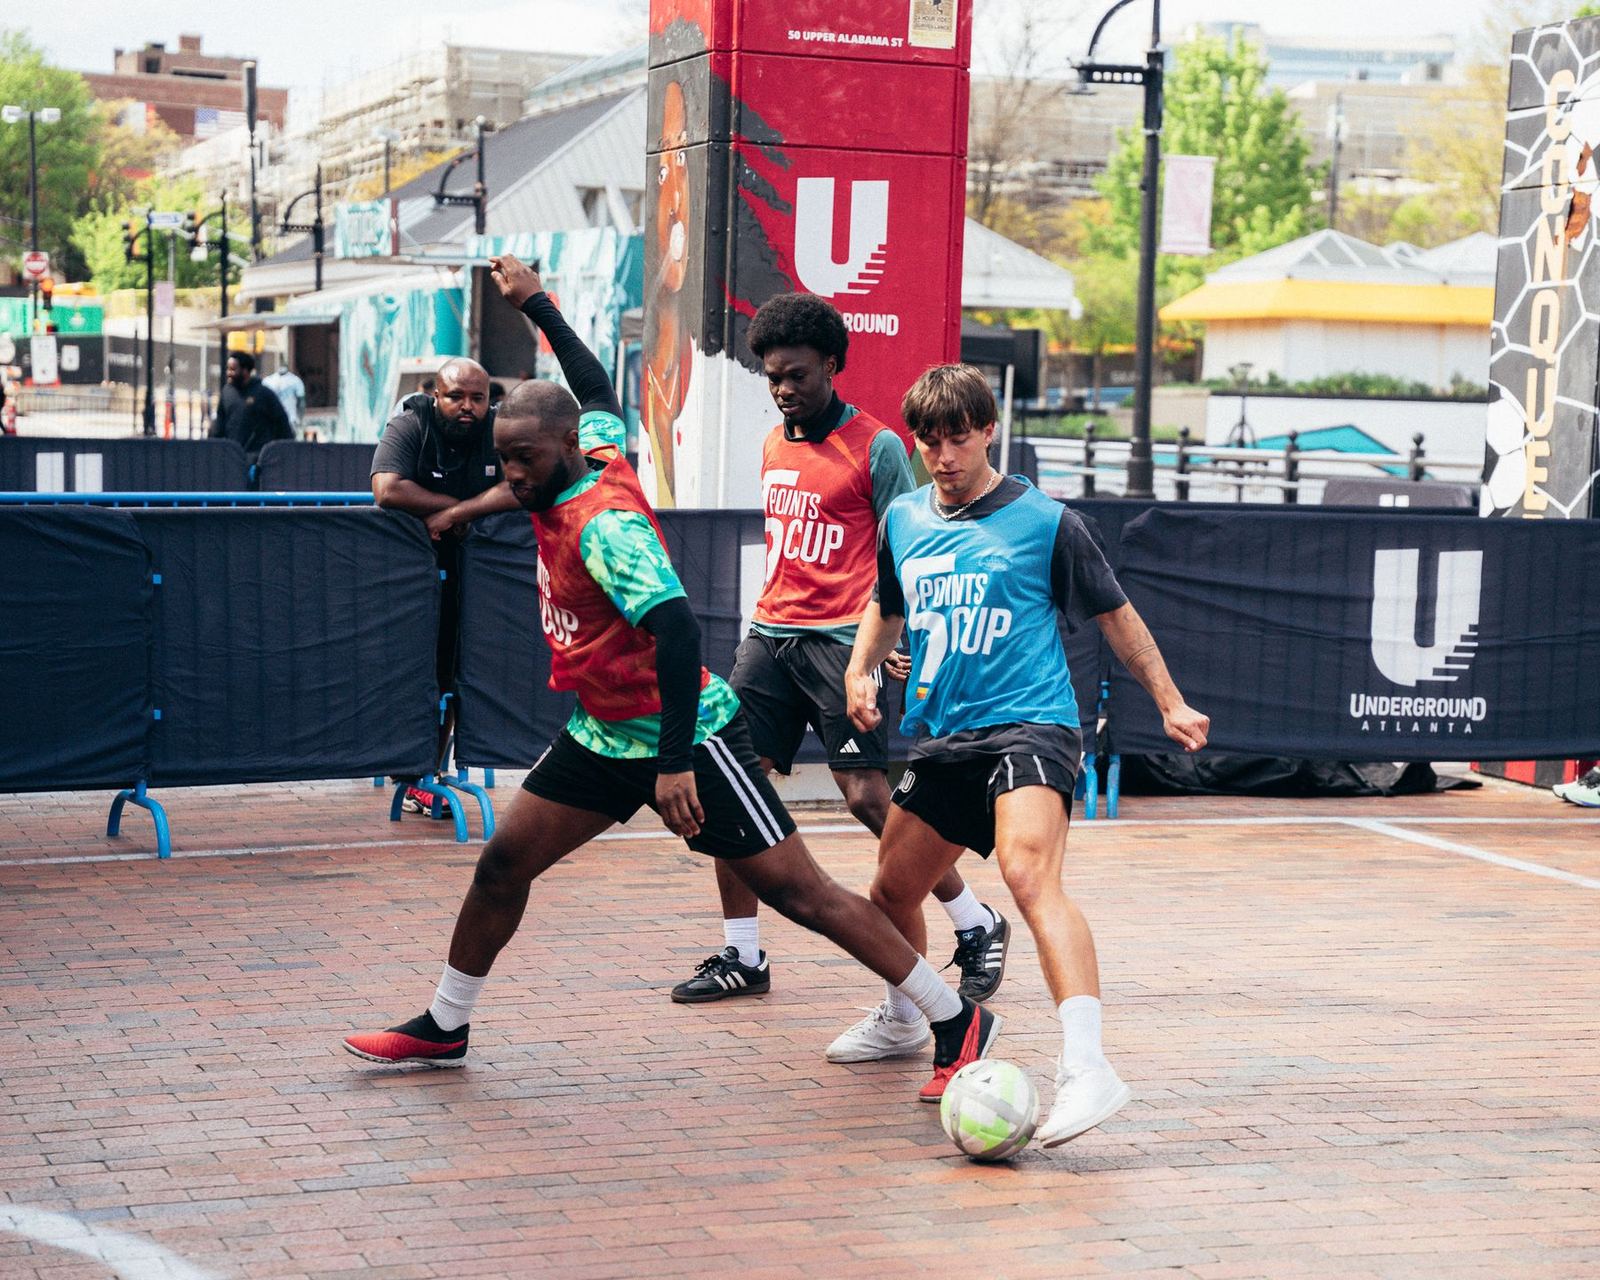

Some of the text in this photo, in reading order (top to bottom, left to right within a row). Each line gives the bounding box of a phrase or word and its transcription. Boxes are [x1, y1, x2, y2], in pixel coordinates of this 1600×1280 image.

[788, 30, 904, 48] 50 UPPER ALABAMA ST
[794, 177, 890, 299] U
[1522, 69, 1576, 519] CONQUE
[769, 487, 821, 520] POINTS
[783, 518, 844, 565] CUP
[918, 573, 988, 609] POINTS
[541, 596, 579, 647] CUP
[901, 553, 956, 685] 5
[951, 605, 1012, 655] CUP
[1371, 548, 1483, 687] U
[1350, 693, 1487, 721] UNDERGROUND
[1361, 720, 1473, 734] ATLANTA
